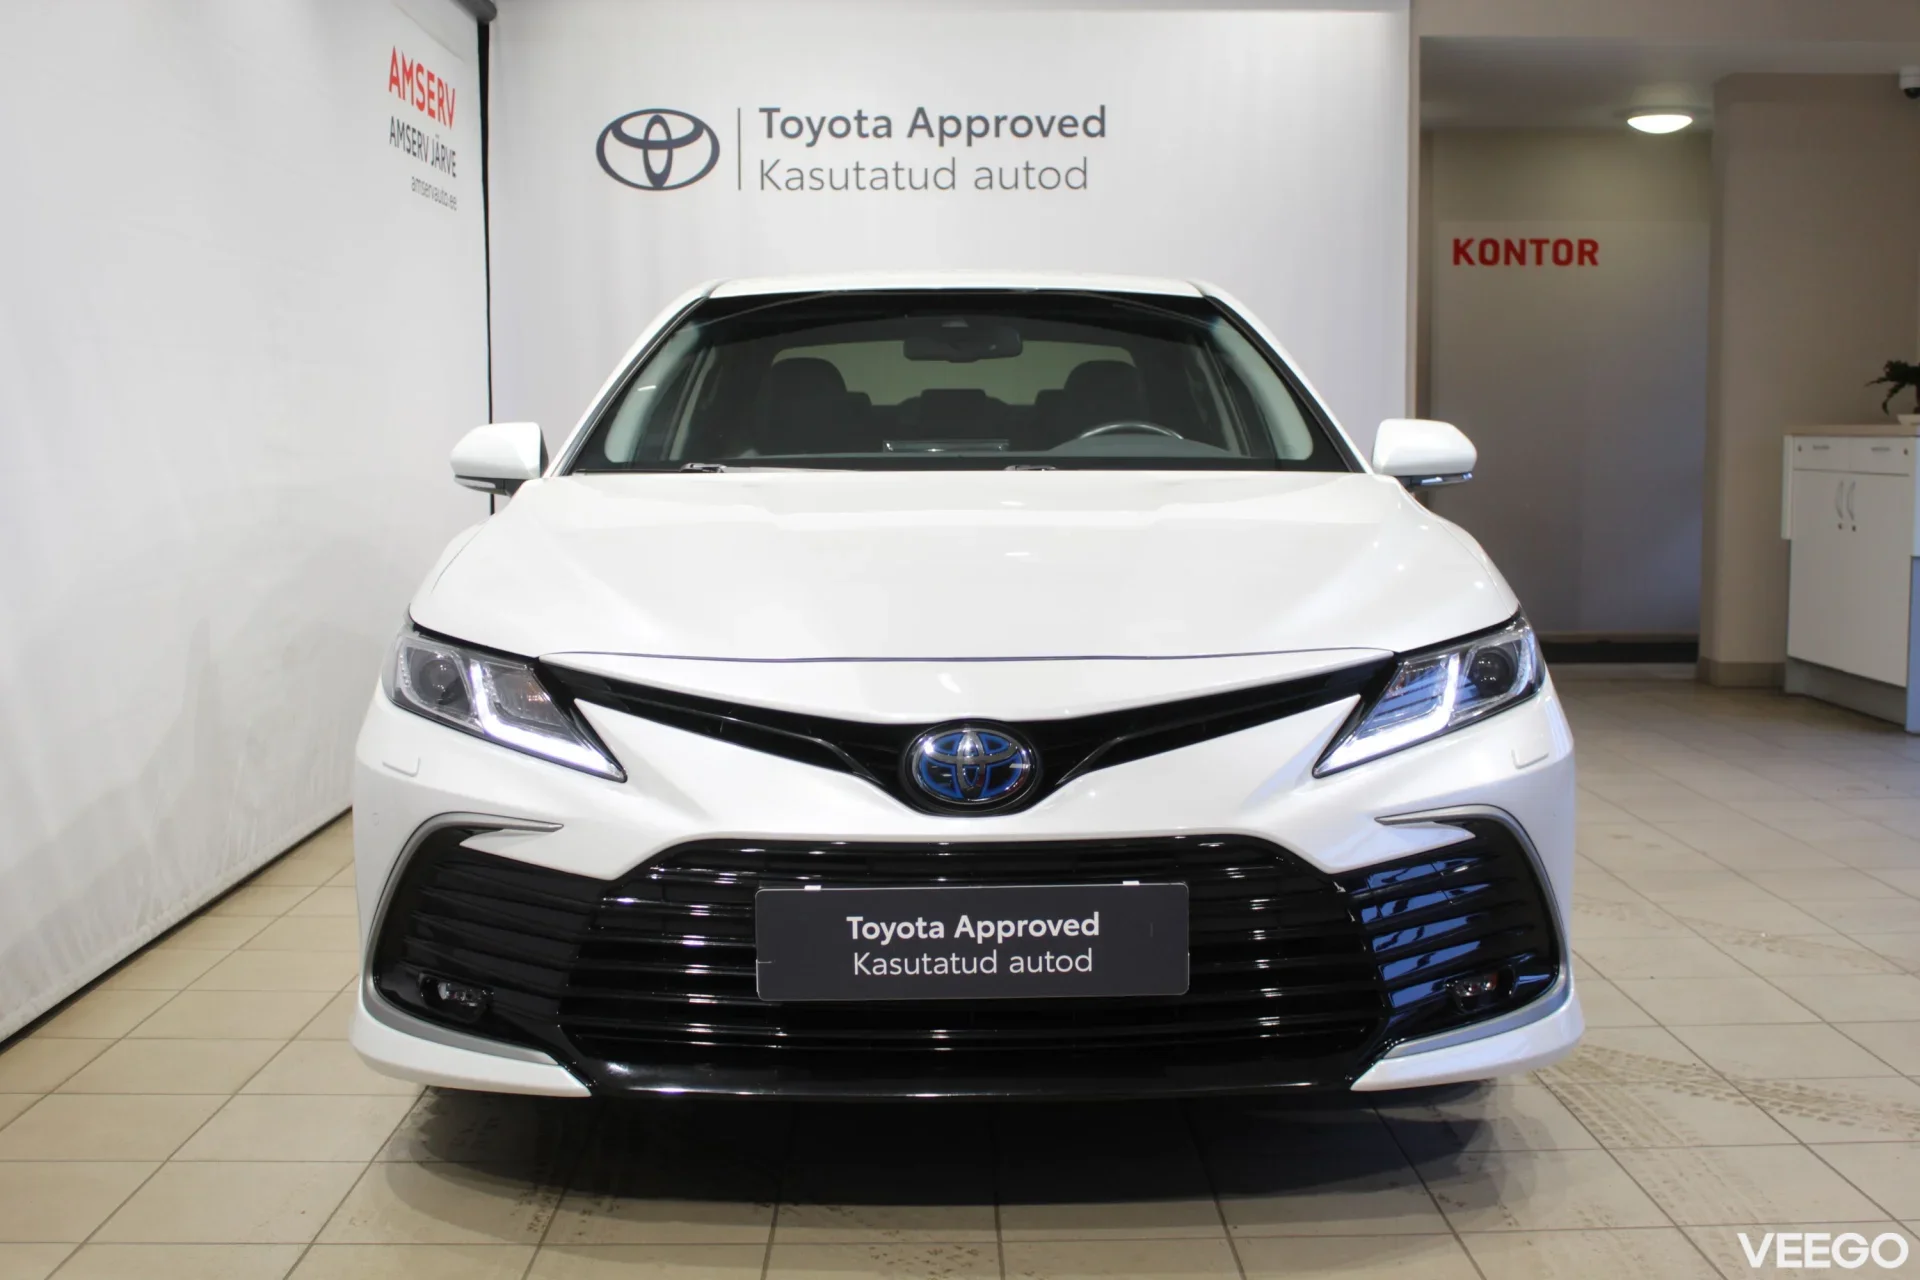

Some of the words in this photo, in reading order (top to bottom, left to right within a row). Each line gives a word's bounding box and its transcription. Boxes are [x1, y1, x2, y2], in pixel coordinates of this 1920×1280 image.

[388, 45, 456, 130] AMSERV
[759, 107, 892, 148] Toyota
[907, 104, 1106, 147] Approved
[389, 115, 430, 163] AMSERV
[430, 134, 457, 178] JÄRVE
[760, 157, 956, 191] Kasutatud
[974, 156, 1087, 190] autod
[411, 175, 457, 211] amservauto.ee
[1453, 238, 1599, 266] KONTOR
[846, 916, 945, 946] Toyota
[954, 911, 1100, 944] Approved
[854, 949, 997, 976] Kasutatud
[1009, 948, 1093, 973] autod
